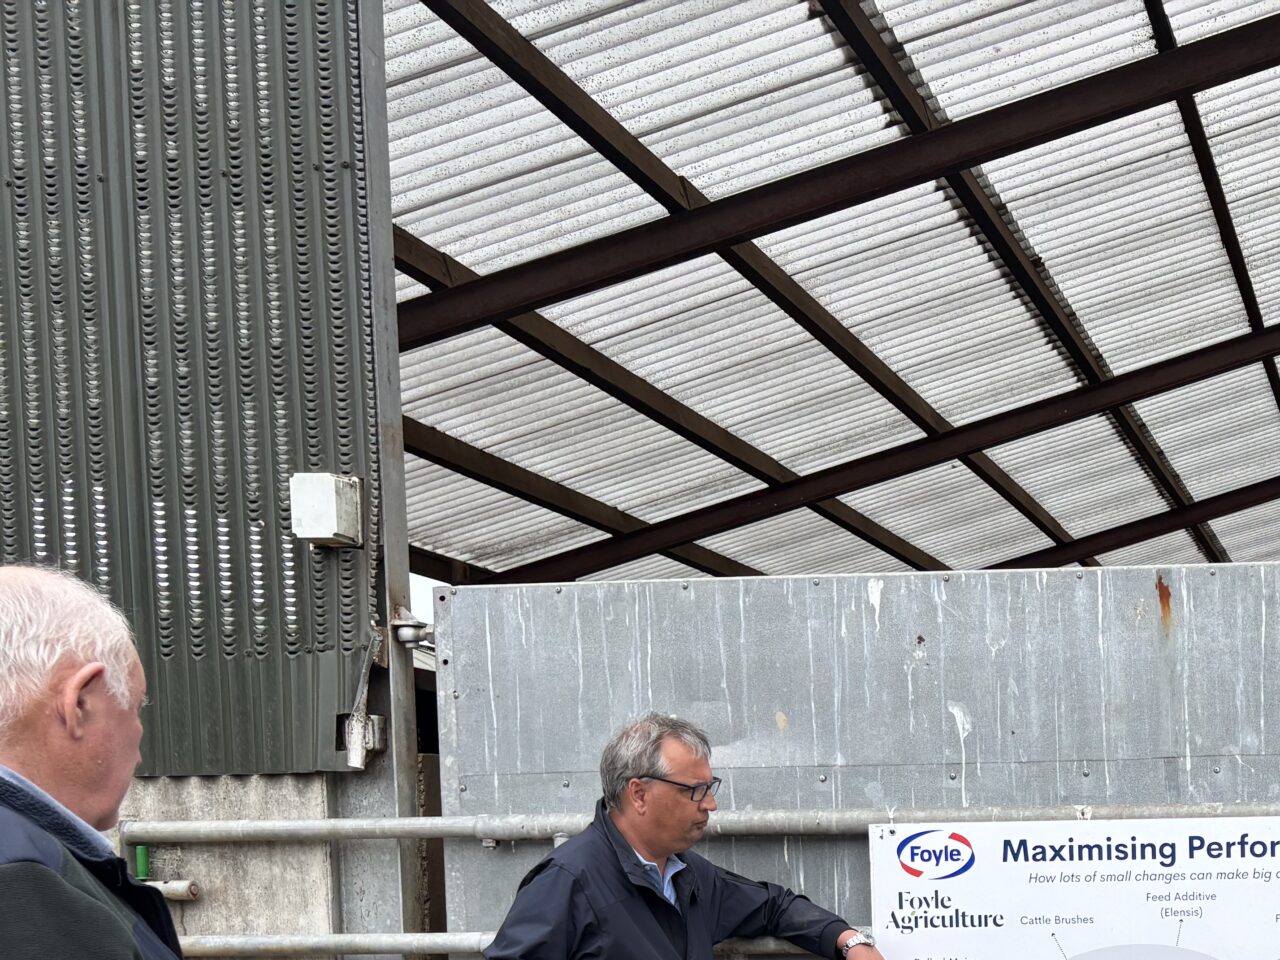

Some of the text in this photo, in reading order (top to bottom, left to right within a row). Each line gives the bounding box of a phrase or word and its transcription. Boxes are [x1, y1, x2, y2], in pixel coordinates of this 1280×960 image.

[910, 845, 961, 866] Foyle
[1002, 836, 1177, 868] Maximising
[1029, 873, 1056, 884] How
[1060, 872, 1081, 882] lots
[1084, 871, 1098, 882] of
[1100, 871, 1131, 882] small
[1135, 870, 1186, 884] changes
[1190, 870, 1212, 881] can
[1216, 868, 1249, 880] make
[1253, 868, 1272, 882] big
[898, 890, 951, 910] Foyle
[1146, 891, 1217, 902] Feed Additive
[886, 909, 1004, 934] Agriculture
[1020, 915, 1094, 925] Cattle Brushes
[1160, 907, 1203, 919] (Elensis)
